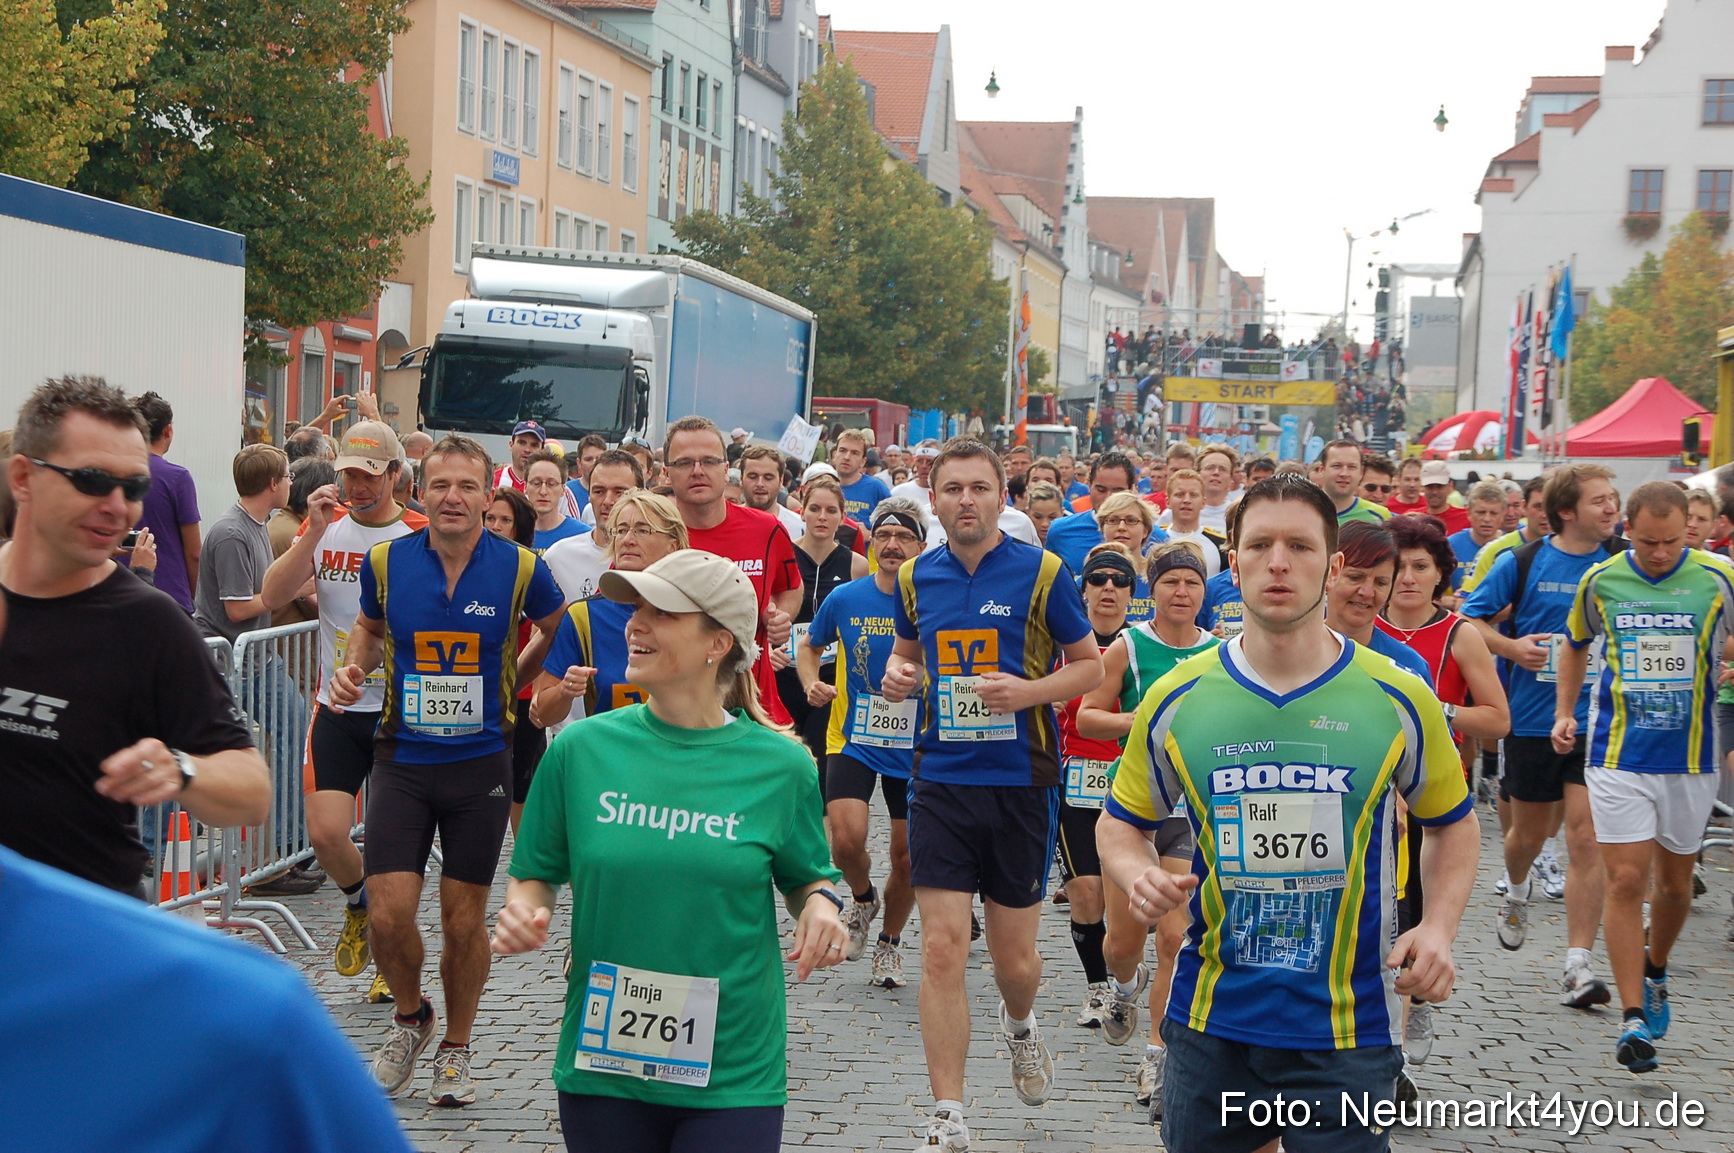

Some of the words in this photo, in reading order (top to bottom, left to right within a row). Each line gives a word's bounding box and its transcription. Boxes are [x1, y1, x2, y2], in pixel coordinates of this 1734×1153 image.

[487, 308, 583, 330] BOCK
[1219, 384, 1279, 399] START
[317, 562, 359, 583] Reis
[1615, 614, 1696, 629] BOCK
[1640, 641, 1671, 651] Marcel
[1643, 656, 1685, 671] 3169
[425, 681, 468, 693] Reinhard
[426, 699, 474, 716] 3374
[873, 700, 889, 713] Hajo
[871, 715, 909, 731] 2803
[1212, 740, 1275, 757] TEAM
[1209, 763, 1355, 795] BOCK
[1249, 803, 1278, 821] Ralf
[1223, 831, 1231, 845] C
[1252, 833, 1329, 859] 3676
[1297, 875, 1346, 885] PFLEIDERER
[623, 976, 662, 1004] Tanja
[591, 1001, 600, 1016] C
[618, 1009, 696, 1045] 2761
[657, 1065, 708, 1079] PFLEIDERER
